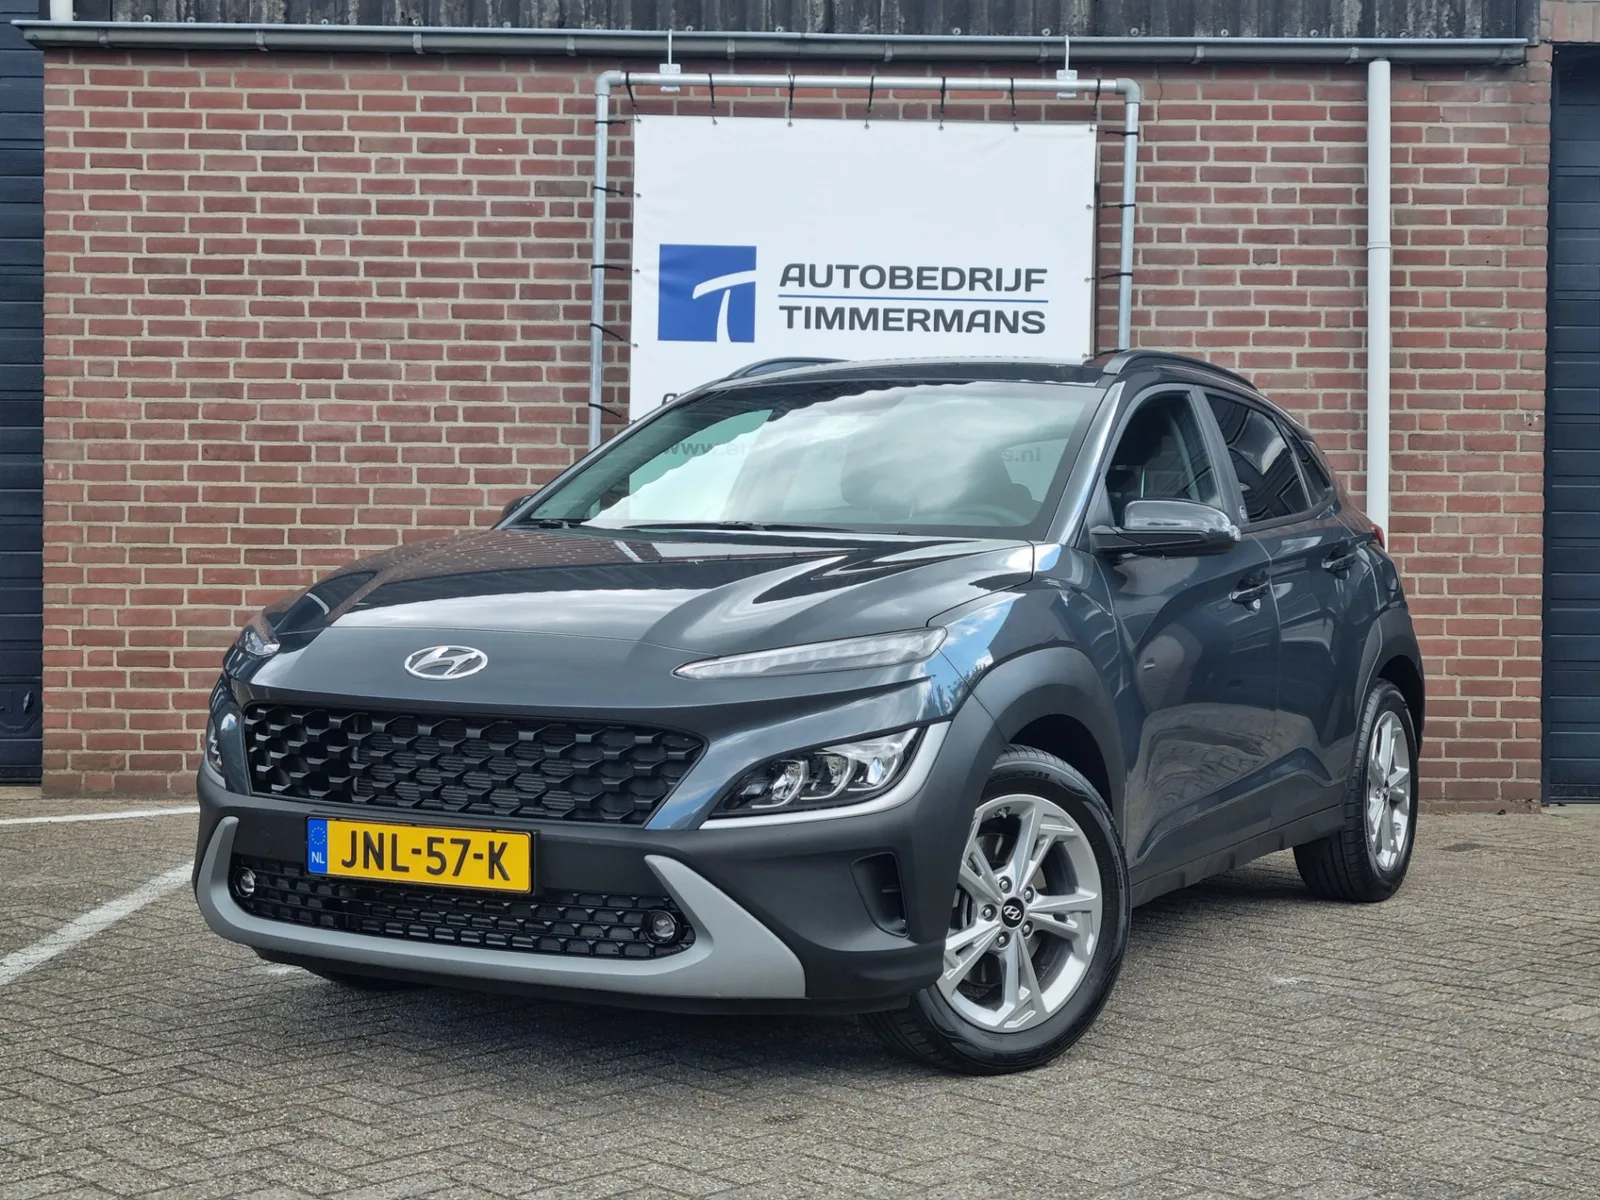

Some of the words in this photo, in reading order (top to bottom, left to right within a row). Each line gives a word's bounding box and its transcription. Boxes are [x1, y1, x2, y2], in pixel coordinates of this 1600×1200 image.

[779, 263, 1048, 293] AUTOBEDRIJF
[778, 305, 1046, 335] TIMMERMANS
[311, 851, 326, 864] NL
[341, 830, 511, 882] JNL-57-K
